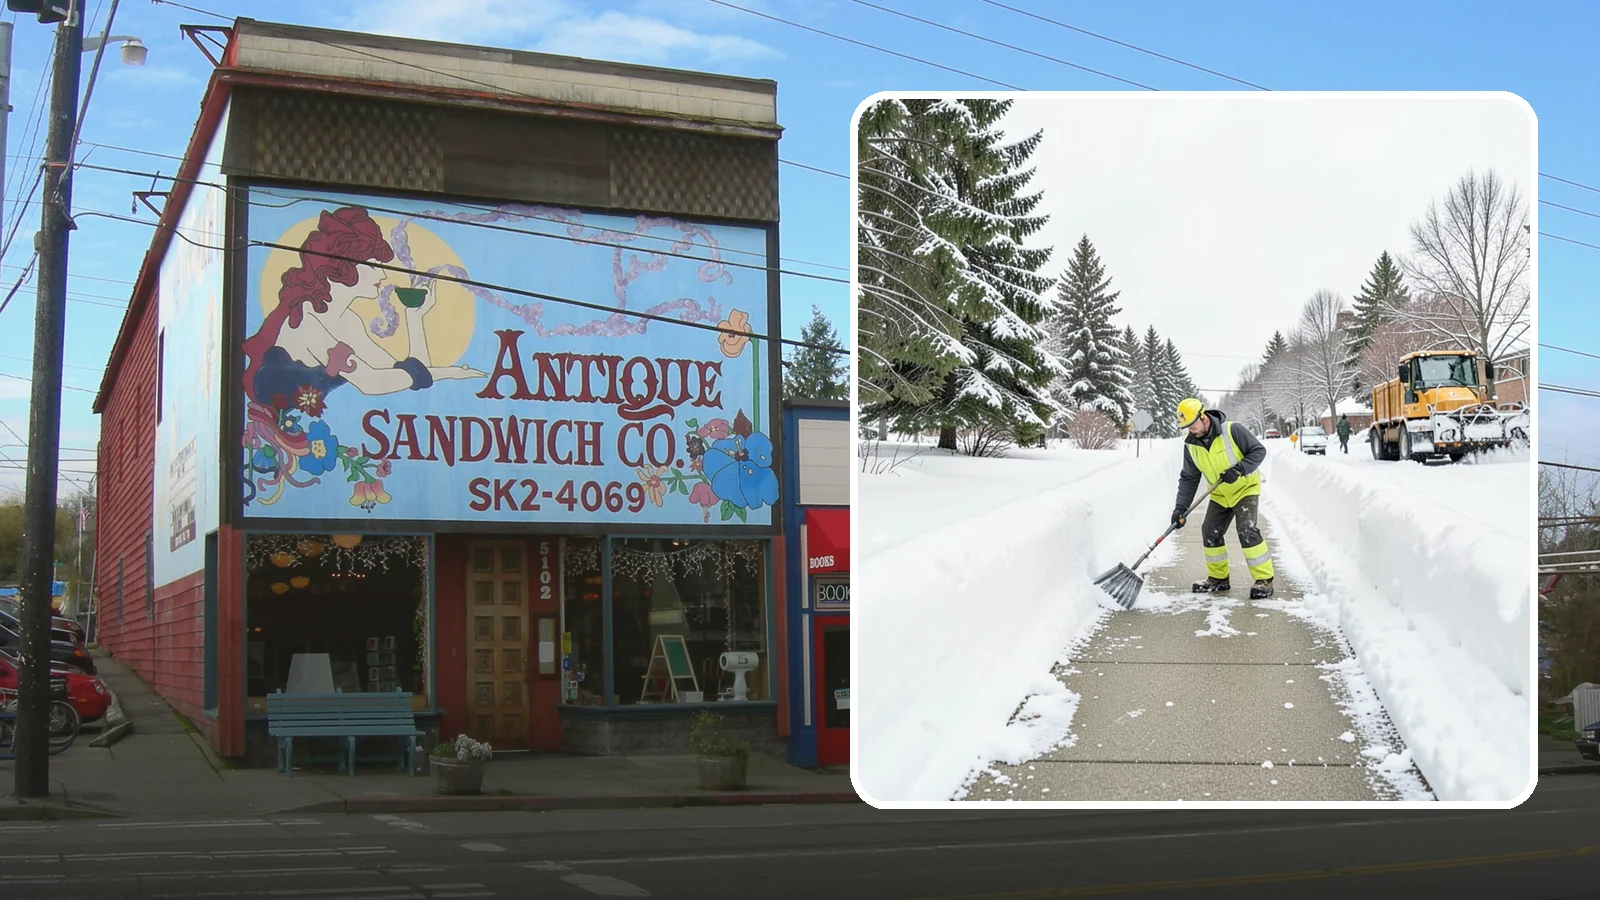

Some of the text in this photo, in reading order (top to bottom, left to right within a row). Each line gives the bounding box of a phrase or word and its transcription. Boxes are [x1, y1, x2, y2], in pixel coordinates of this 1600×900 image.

[476, 329, 723, 421] ANTIQUE
[361, 408, 684, 468] SANDWICH CO.
[470, 477, 645, 513] SK2-4069
[540, 543, 552, 599] 5102
[809, 555, 835, 568] BOOKS
